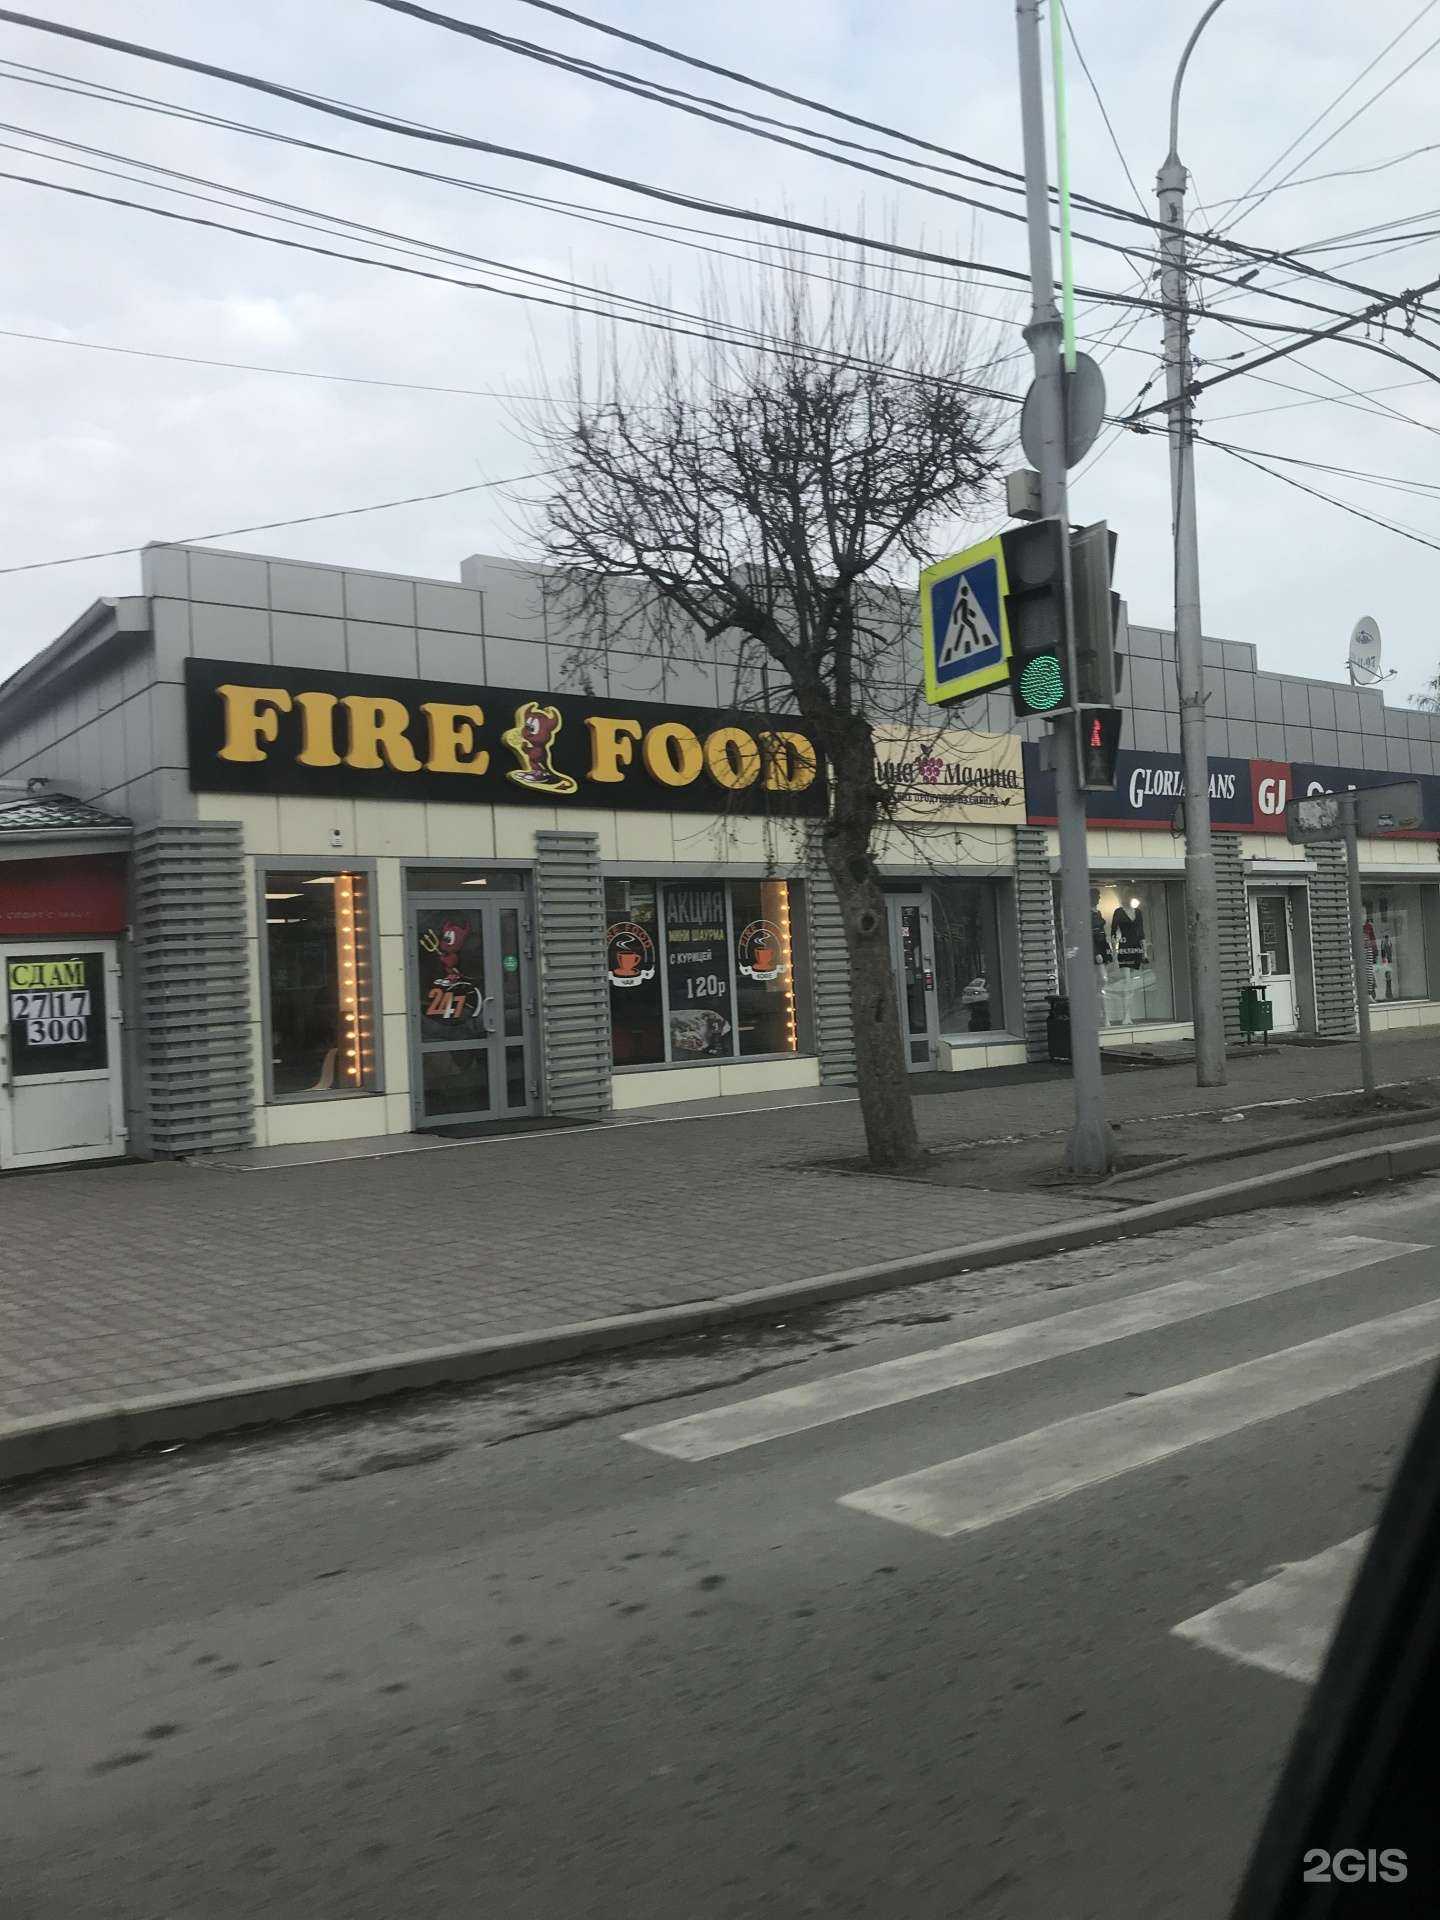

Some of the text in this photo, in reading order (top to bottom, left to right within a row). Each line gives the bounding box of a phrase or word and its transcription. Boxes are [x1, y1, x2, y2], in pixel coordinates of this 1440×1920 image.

[216, 684, 817, 792] FIRE FOOD
[944, 763, 1018, 789] Малина
[1208, 774, 1235, 799] ANS
[1258, 778, 1287, 815] GJ
[667, 891, 724, 925] АКЦИЯ
[12, 962, 84, 988] СДАМ
[30, 1019, 83, 1044] 300
